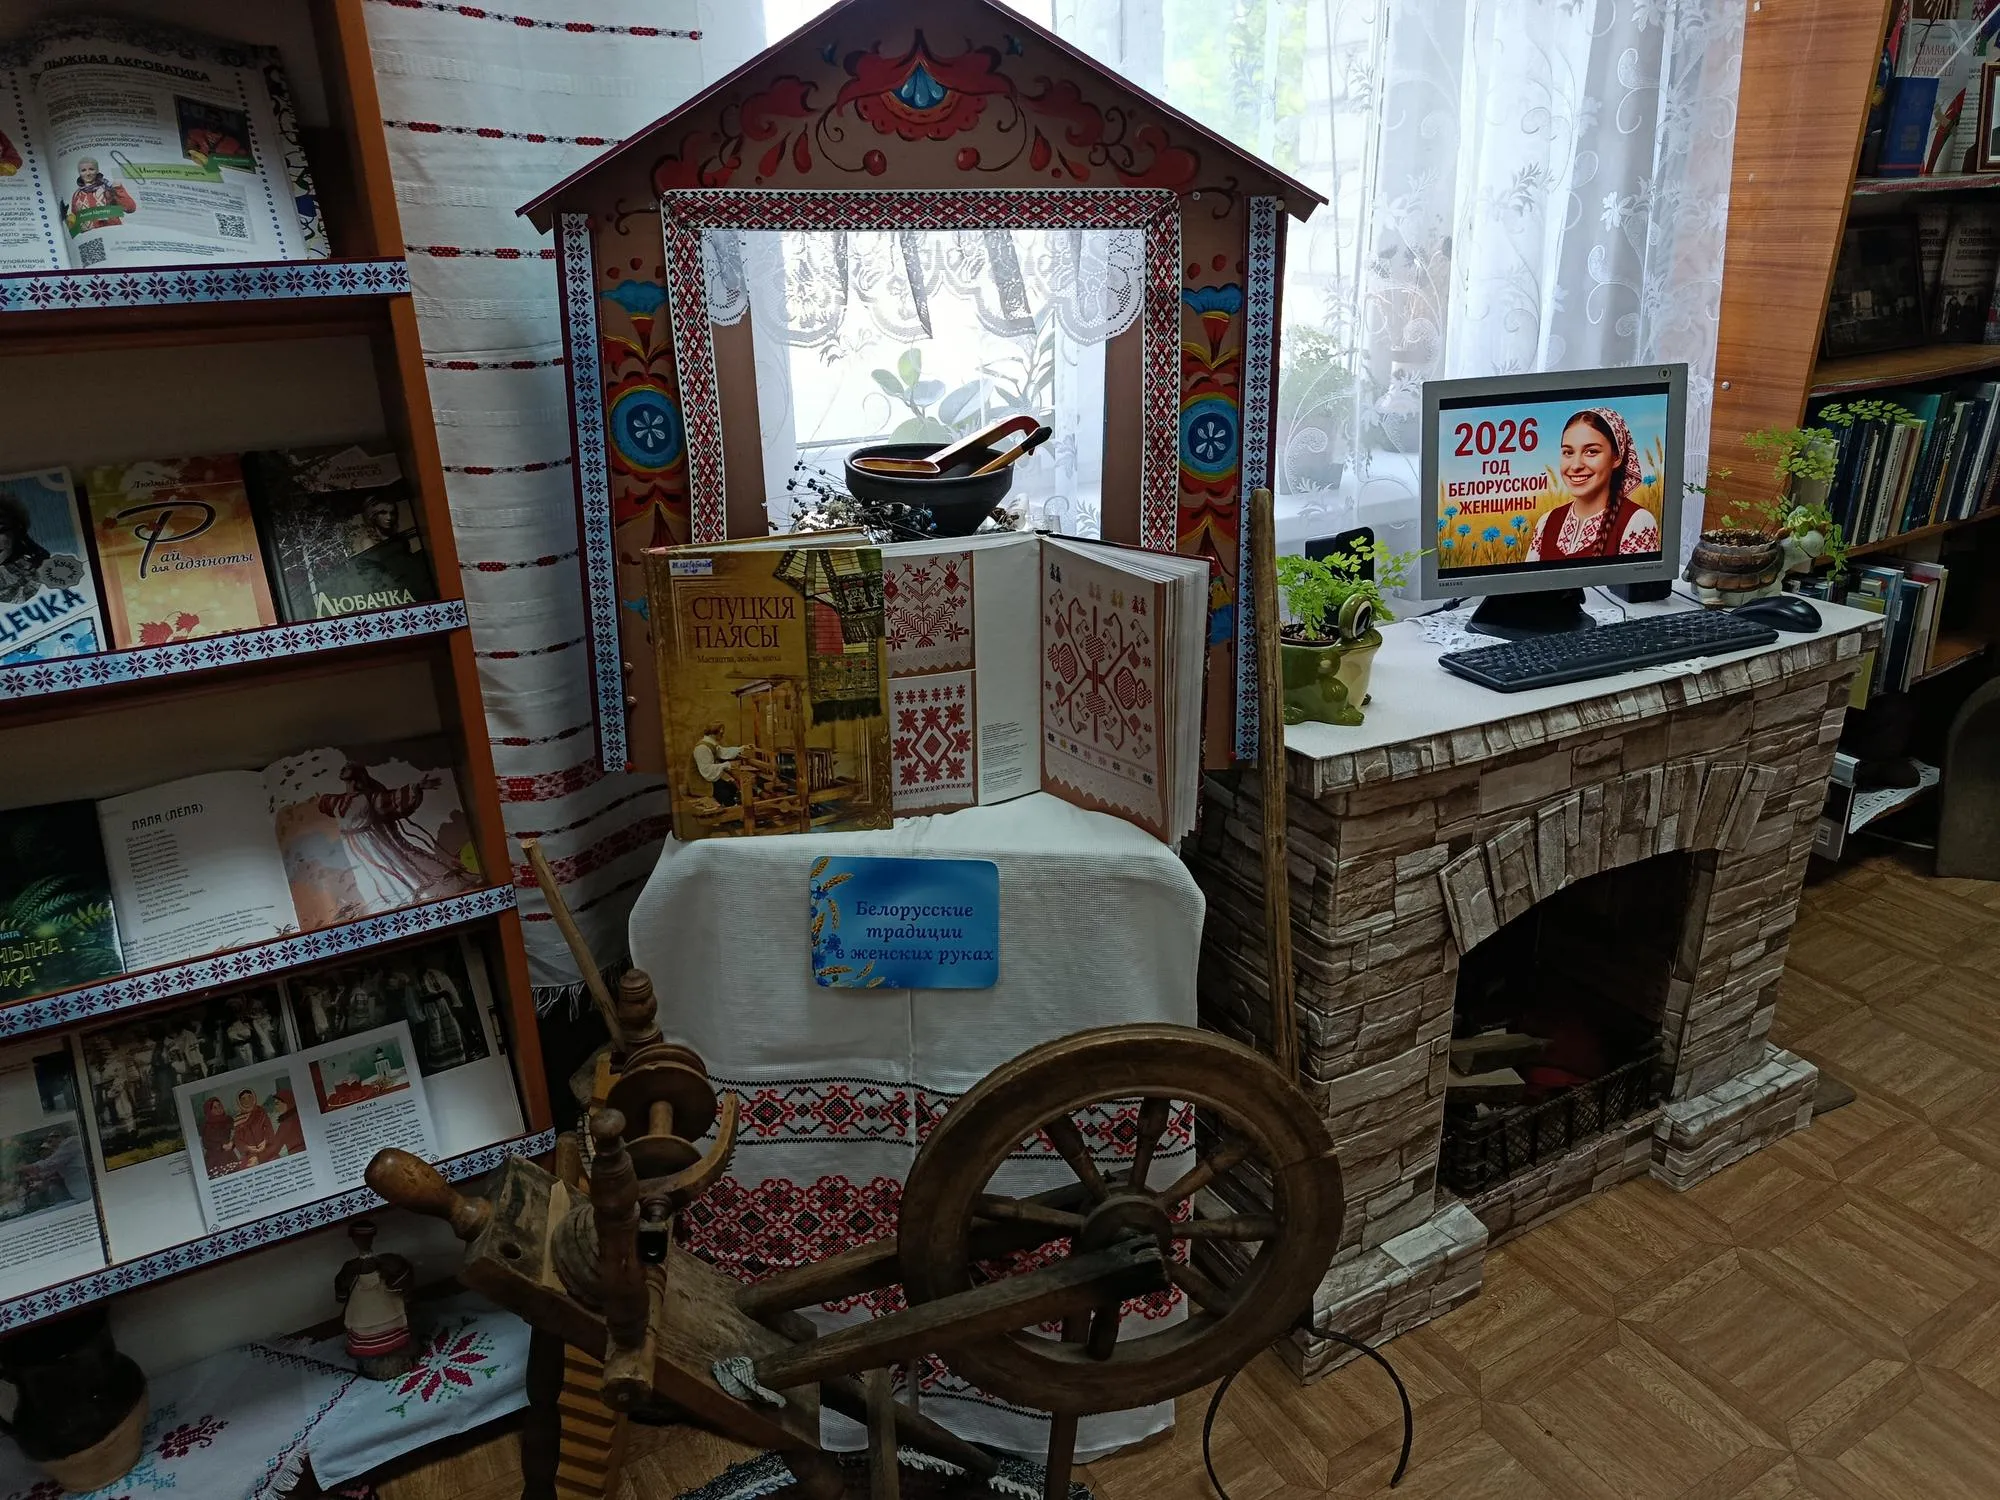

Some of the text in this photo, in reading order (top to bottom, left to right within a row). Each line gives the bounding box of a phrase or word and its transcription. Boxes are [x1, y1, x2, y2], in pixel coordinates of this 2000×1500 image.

[44, 54, 211, 82] ЛЫЖНАЯ АКРОБАТИКА
[1454, 417, 1539, 457] 2026
[1482, 459, 1510, 476] ГОД
[1448, 472, 1548, 497] БЕЛОРУССКОЙ
[1459, 495, 1537, 515] ЖЕНЩИНЫ
[151, 552, 254, 573] для адзіноты
[316, 588, 417, 620] ЛЮБАЧКА
[692, 596, 797, 625] СЛУЦКІЯ
[693, 624, 780, 648] ПАЯСЫ
[132, 814, 162, 830] ЛЯЛЯ
[855, 900, 974, 921] Белорусские
[866, 923, 964, 942] традиции
[835, 947, 995, 965] в женских руках
[0, 966, 36, 988] КА
